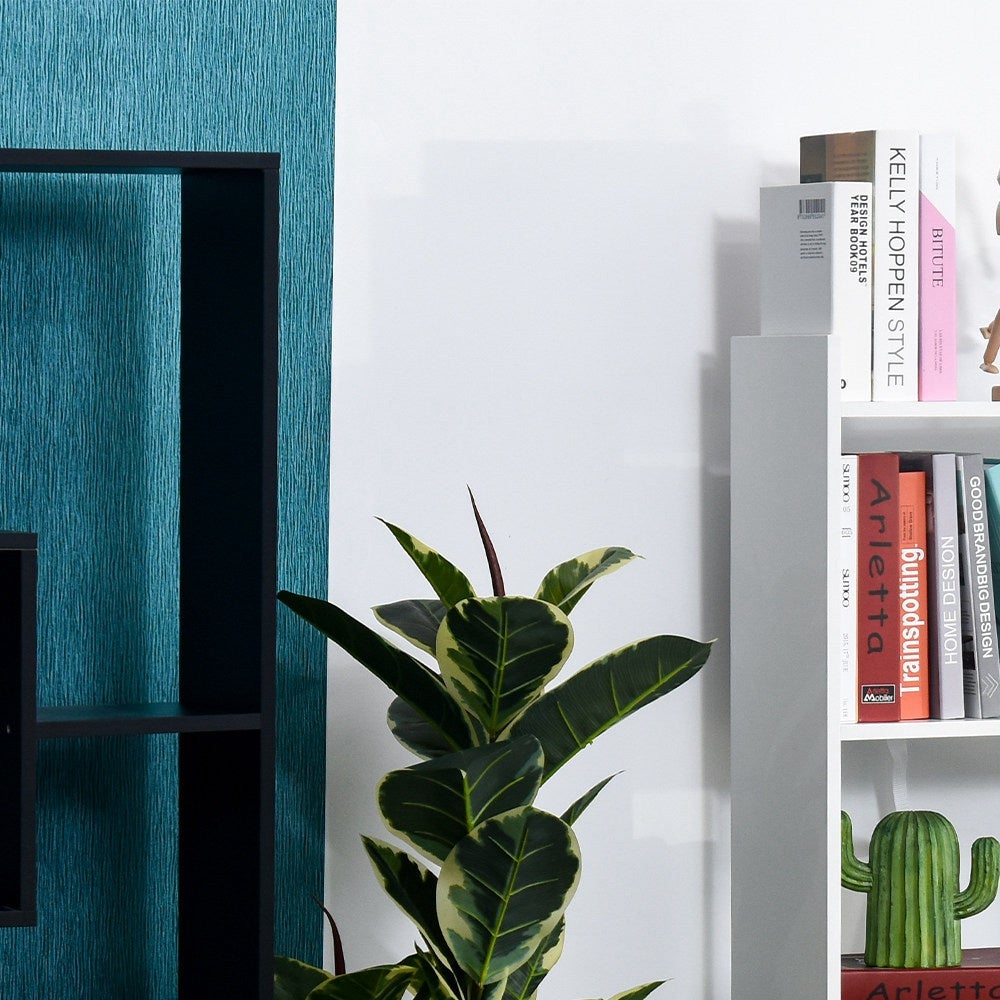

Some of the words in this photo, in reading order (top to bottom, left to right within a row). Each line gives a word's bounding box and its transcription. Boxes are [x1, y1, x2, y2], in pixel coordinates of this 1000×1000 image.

[849, 194, 859, 223] YEAR
[889, 147, 906, 214] KELLY
[859, 194, 869, 236] DESIGN
[858, 240, 868, 284] HOTELS
[888, 220, 906, 311] HOPPEN
[931, 227, 944, 288] BITUTE
[887, 318, 905, 388] STYLE
[867, 478, 893, 655] Arletta
[941, 535, 957, 602] DESION
[944, 609, 958, 665] HOME
